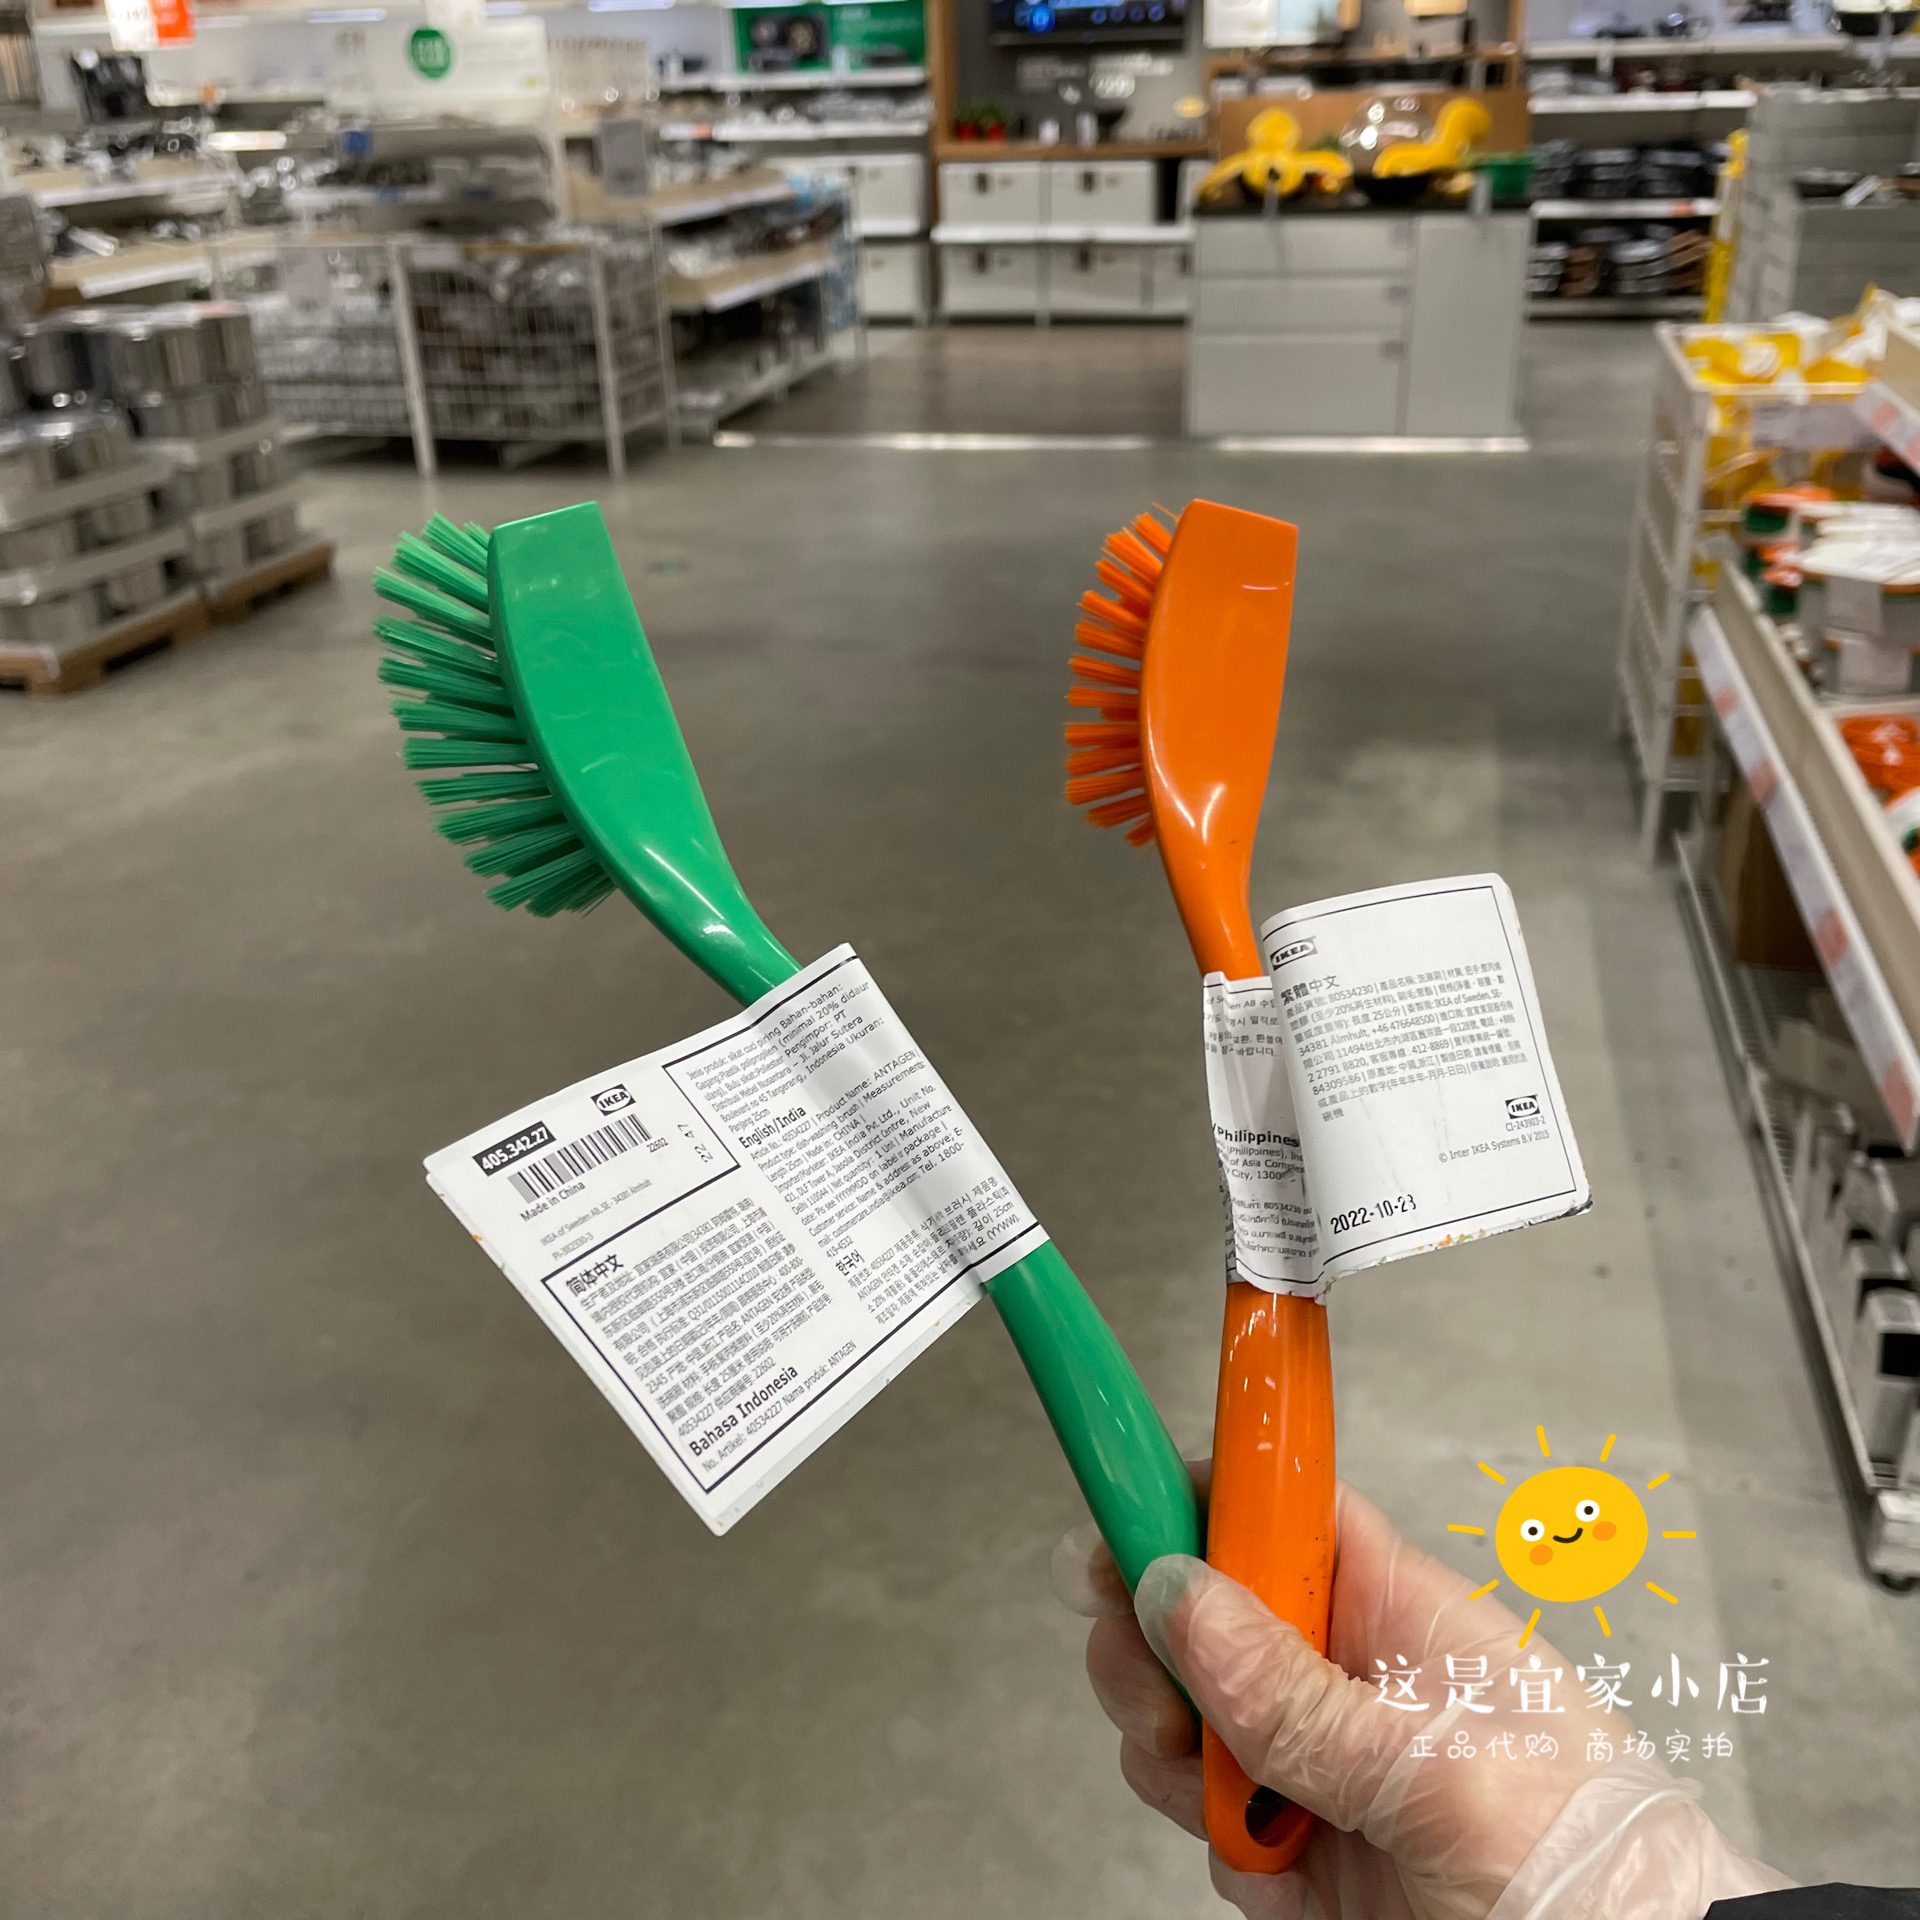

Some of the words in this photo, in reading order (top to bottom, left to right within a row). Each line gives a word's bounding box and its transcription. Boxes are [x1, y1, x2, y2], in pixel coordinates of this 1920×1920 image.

[1274, 943, 1310, 963] IKEA
[1279, 973, 1341, 1006] 繁體中文
[1328, 984, 1374, 1003] 80534230
[1434, 996, 1452, 1008] IKEA
[1453, 995, 1462, 1004] of
[1462, 990, 1491, 1003] Sweden,
[756, 1026, 782, 1047] piring
[779, 983, 844, 1029] Bahan-bahan:
[777, 1014, 817, 1047] (minimal
[815, 999, 840, 1020] 20%
[839, 980, 871, 1005] didaur
[783, 1019, 835, 1058] Pengimpor:
[833, 1009, 848, 1022] PT
[1298, 1038, 1329, 1056] 34381
[1371, 1023, 1389, 1035] +46
[1389, 1013, 1435, 1031] 476648500
[757, 1066, 792, 1089] Nusantara
[809, 1035, 831, 1055] Jalur
[830, 1015, 864, 1040] Sutera
[758, 1093, 768, 1104] 45
[766, 1071, 808, 1099] Tangerang,
[804, 1040, 846, 1073] Indonesia
[845, 1016, 885, 1045] Ukuran:
[1307, 1073, 1315, 1082] 2
[1315, 1064, 1341, 1079] 2791
[1342, 1057, 1369, 1071] 8820,
[598, 1089, 629, 1110] IKEA
[1312, 1073, 1361, 1095] 84309586
[728, 1116, 755, 1135] Panjang
[751, 1106, 770, 1122] 25cm
[738, 1103, 808, 1152] English/India
[750, 1144, 770, 1161] Article
[780, 1120, 812, 1143] 40534227
[815, 1096, 848, 1122] Product
[845, 1078, 873, 1100] Name:
[827, 1144, 847, 1161] IKEA
[844, 1129, 867, 1149] India
[900, 1091, 922, 1109] Unit
[921, 1083, 936, 1096] No.
[1505, 1116, 1545, 1132] CI-243903-2
[1511, 1101, 1535, 1112] IKEA
[479, 1125, 550, 1173] 405.342.27
[758, 1153, 783, 1172] Product
[794, 1119, 839, 1151] dish-washing
[837, 1102, 861, 1123] brush
[766, 1165, 789, 1184] Length
[785, 1156, 804, 1172] 25cm
[806, 1143, 825, 1159] Made
[832, 1118, 862, 1141] CHINA
[796, 1183, 810, 1196] DLF
[807, 1173, 827, 1190] Tower
[832, 1154, 855, 1173] Jasola
[852, 1134, 883, 1159] District
[880, 1114, 910, 1139] Centre,
[909, 1100, 932, 1119] New
[918, 1158, 938, 1175] Tel.
[937, 1140, 966, 1162] 1800-
[1449, 1147, 1471, 1160] Inter
[1471, 1142, 1491, 1155] IKEA
[1491, 1136, 1521, 1151] Systems
[1534, 1130, 1550, 1141] 2015
[520, 1200, 549, 1222] Made
[547, 1194, 560, 1208] in
[558, 1179, 586, 1201] China
[647, 1136, 669, 1153] 22602
[791, 1200, 809, 1215] Delhi
[806, 1187, 830, 1206] 110044
[831, 1177, 844, 1190] Net
[841, 1156, 876, 1184] quantity:
[875, 1150, 883, 1158] 1
[808, 1215, 837, 1237] Customer
[834, 1200, 859, 1220] service:
[856, 1187, 878, 1204] Name
[875, 1181, 884, 1191] &
[910, 1154, 922, 1165] as
[954, 1126, 964, 1136] E-
[824, 1199, 836, 1210] see
[868, 1169, 880, 1179] on
[878, 1153, 899, 1173] label
[902, 1124, 942, 1156] package
[1231, 1168, 1254, 1181] City,
[1242, 1159, 1261, 1167] Asia
[1264, 1159, 1305, 1173] Complex
[943, 1193, 972, 1216] 브러시
[972, 1213, 994, 1232] 길이
[993, 1200, 1015, 1218] 25cm
[1263, 1201, 1301, 1214] 80534230
[1329, 1193, 1417, 1235] 2022-10-23
[541, 1232, 558, 1246] IKEA
[564, 1212, 592, 1232] Sweden
[825, 1235, 854, 1259] 419-4532
[564, 1251, 625, 1297] 简体中文
[834, 1249, 865, 1277] 한국어
[868, 1248, 896, 1271] 40534227
[856, 1277, 884, 1300] ANTAGEN
[644, 1372, 669, 1393] 2345
[740, 1296, 775, 1324] ANTAGEN
[676, 1403, 716, 1437] 40534227
[751, 1356, 777, 1379] 22602
[687, 1412, 741, 1456] Bahasa
[735, 1364, 800, 1419] Indonesia
[701, 1455, 720, 1472] No.
[716, 1432, 748, 1460] Artikel:
[743, 1401, 785, 1436] 40534227
[781, 1384, 806, 1406] Nama
[802, 1363, 832, 1390] produk:
[827, 1340, 858, 1368] ANTAGEN
